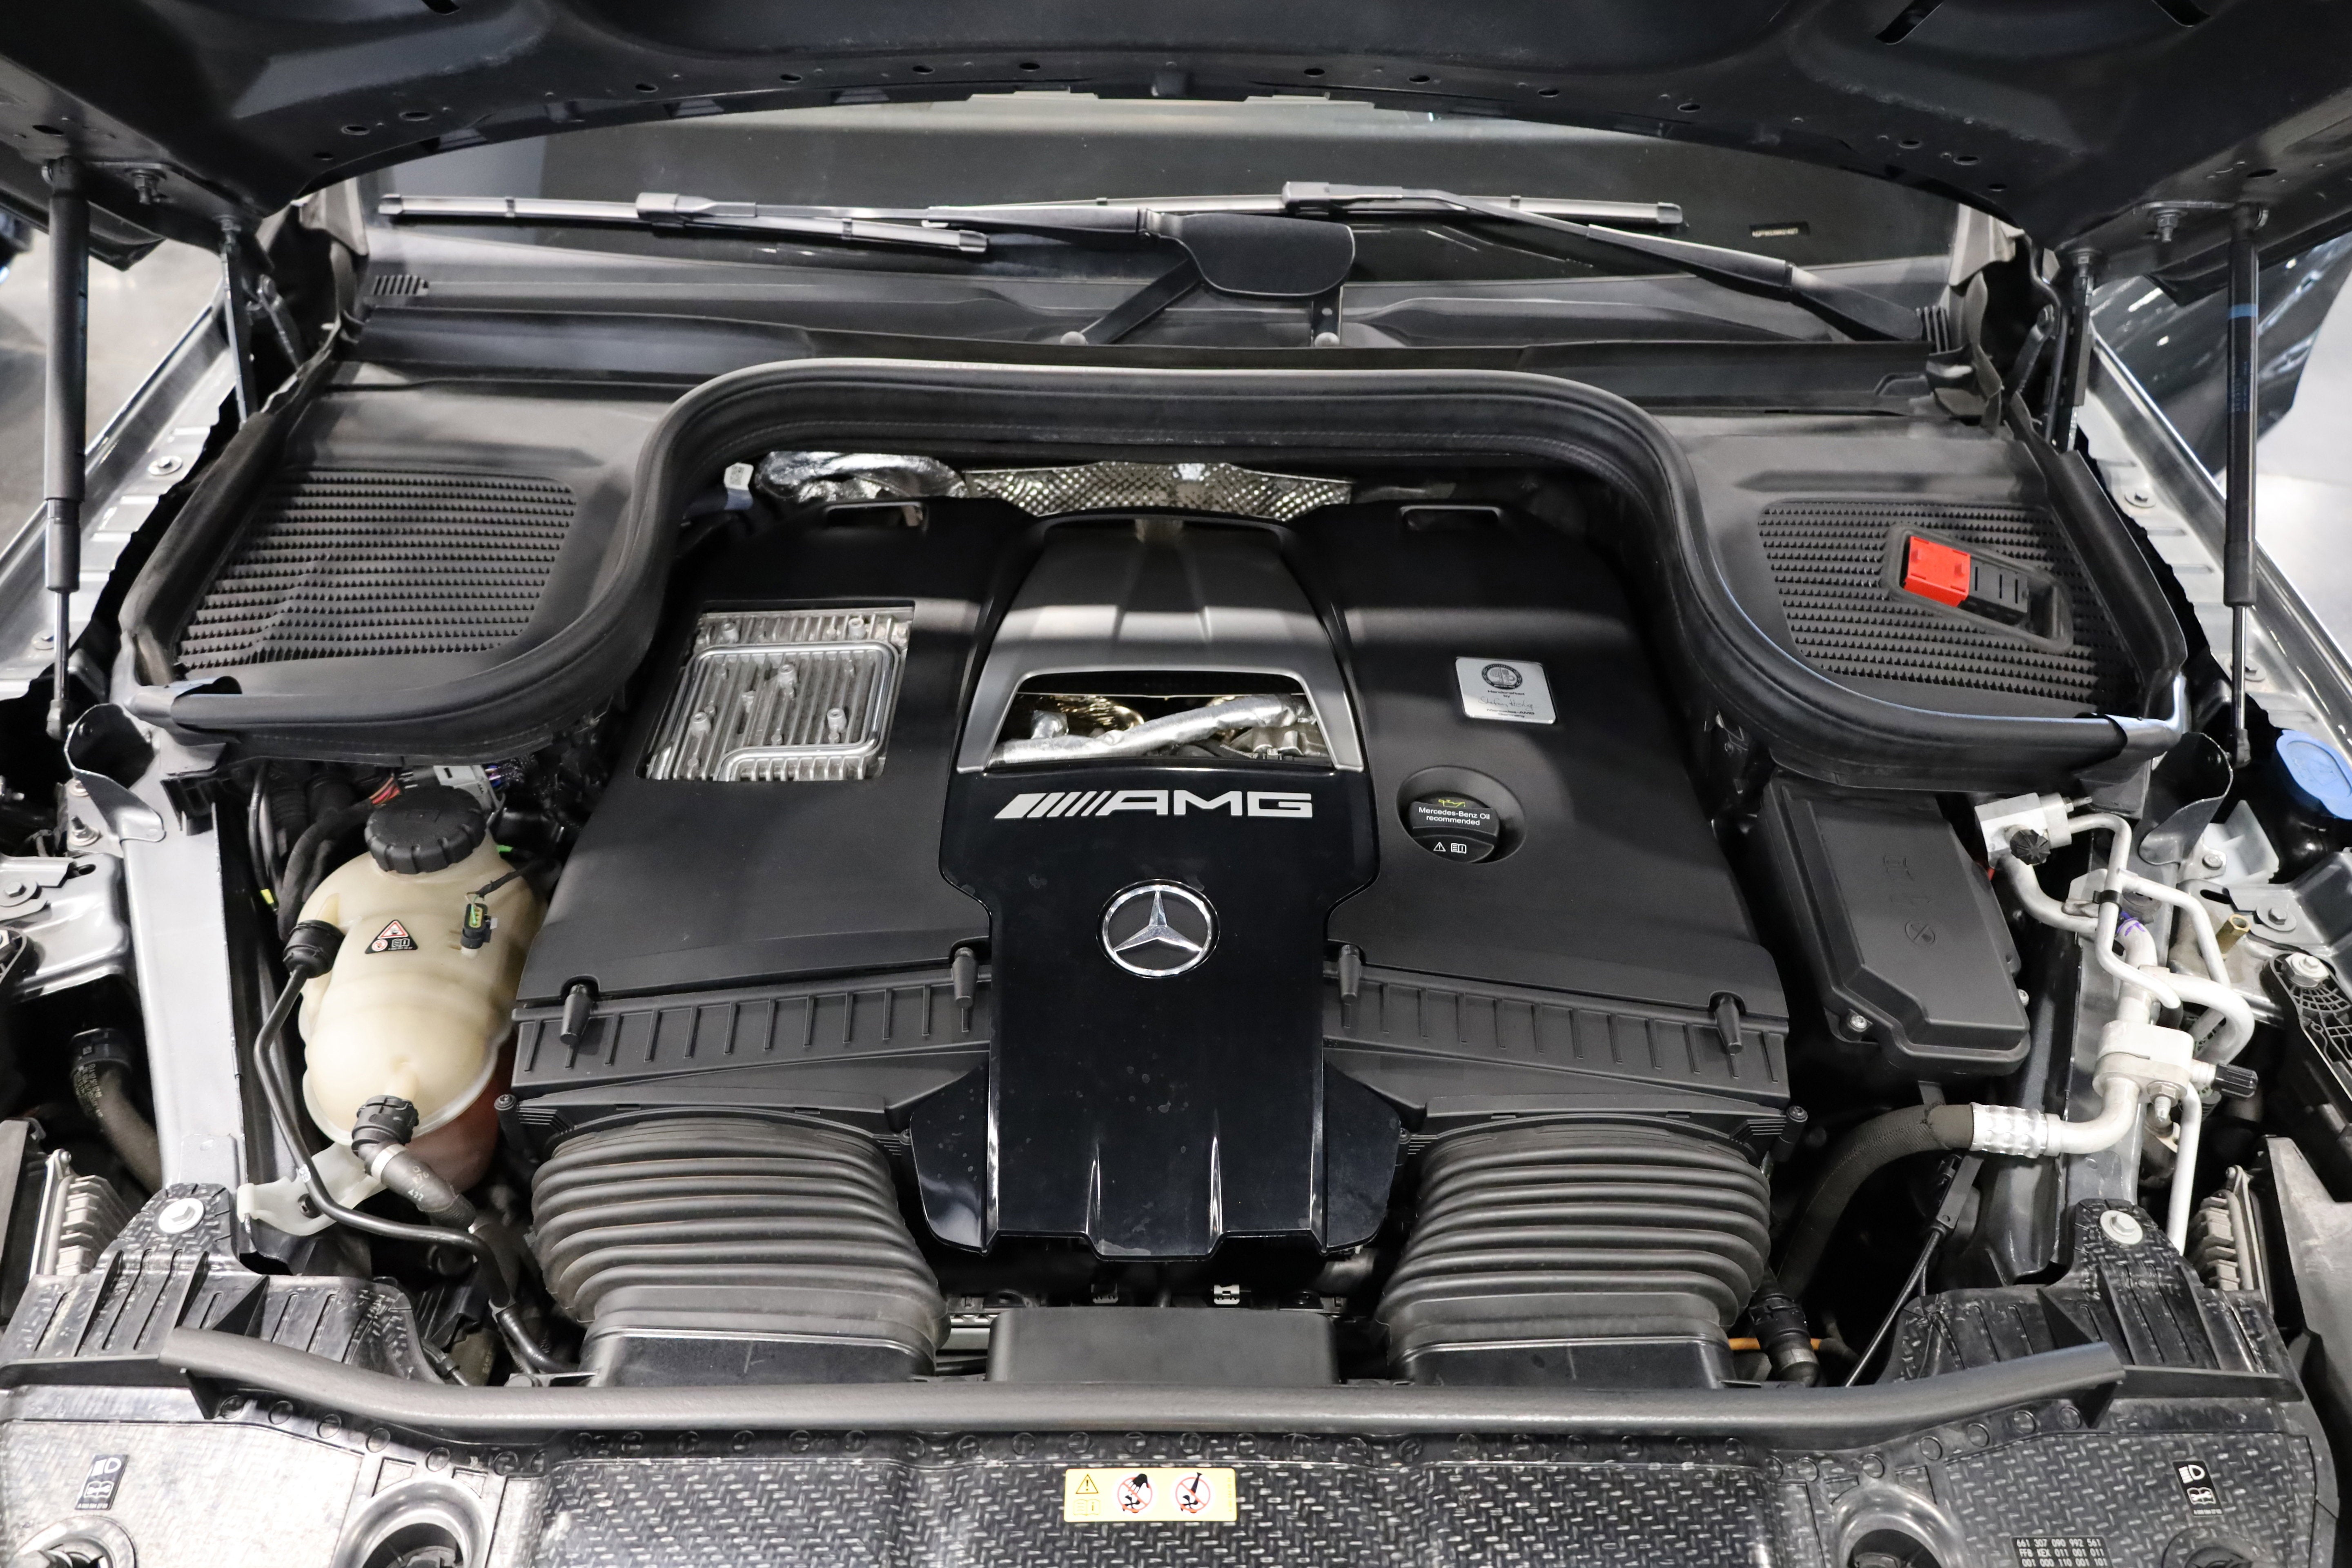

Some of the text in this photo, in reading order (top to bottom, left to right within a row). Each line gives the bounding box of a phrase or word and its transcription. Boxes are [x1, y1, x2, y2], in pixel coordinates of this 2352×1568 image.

[1095, 790, 1313, 818] AMG
[1419, 807, 1478, 819] Mercedes-Benz
[1426, 815, 1480, 826] recommended
[2016, 1538, 2102, 1547] 661 307 090 992 561
[2036, 1548, 2052, 1557] KEX
[2054, 1548, 2069, 1557] 011
[2072, 1548, 2087, 1557] 001
[2090, 1548, 2105, 1557] 011
[2022, 1558, 2108, 1567] 001 000 110 001 101
